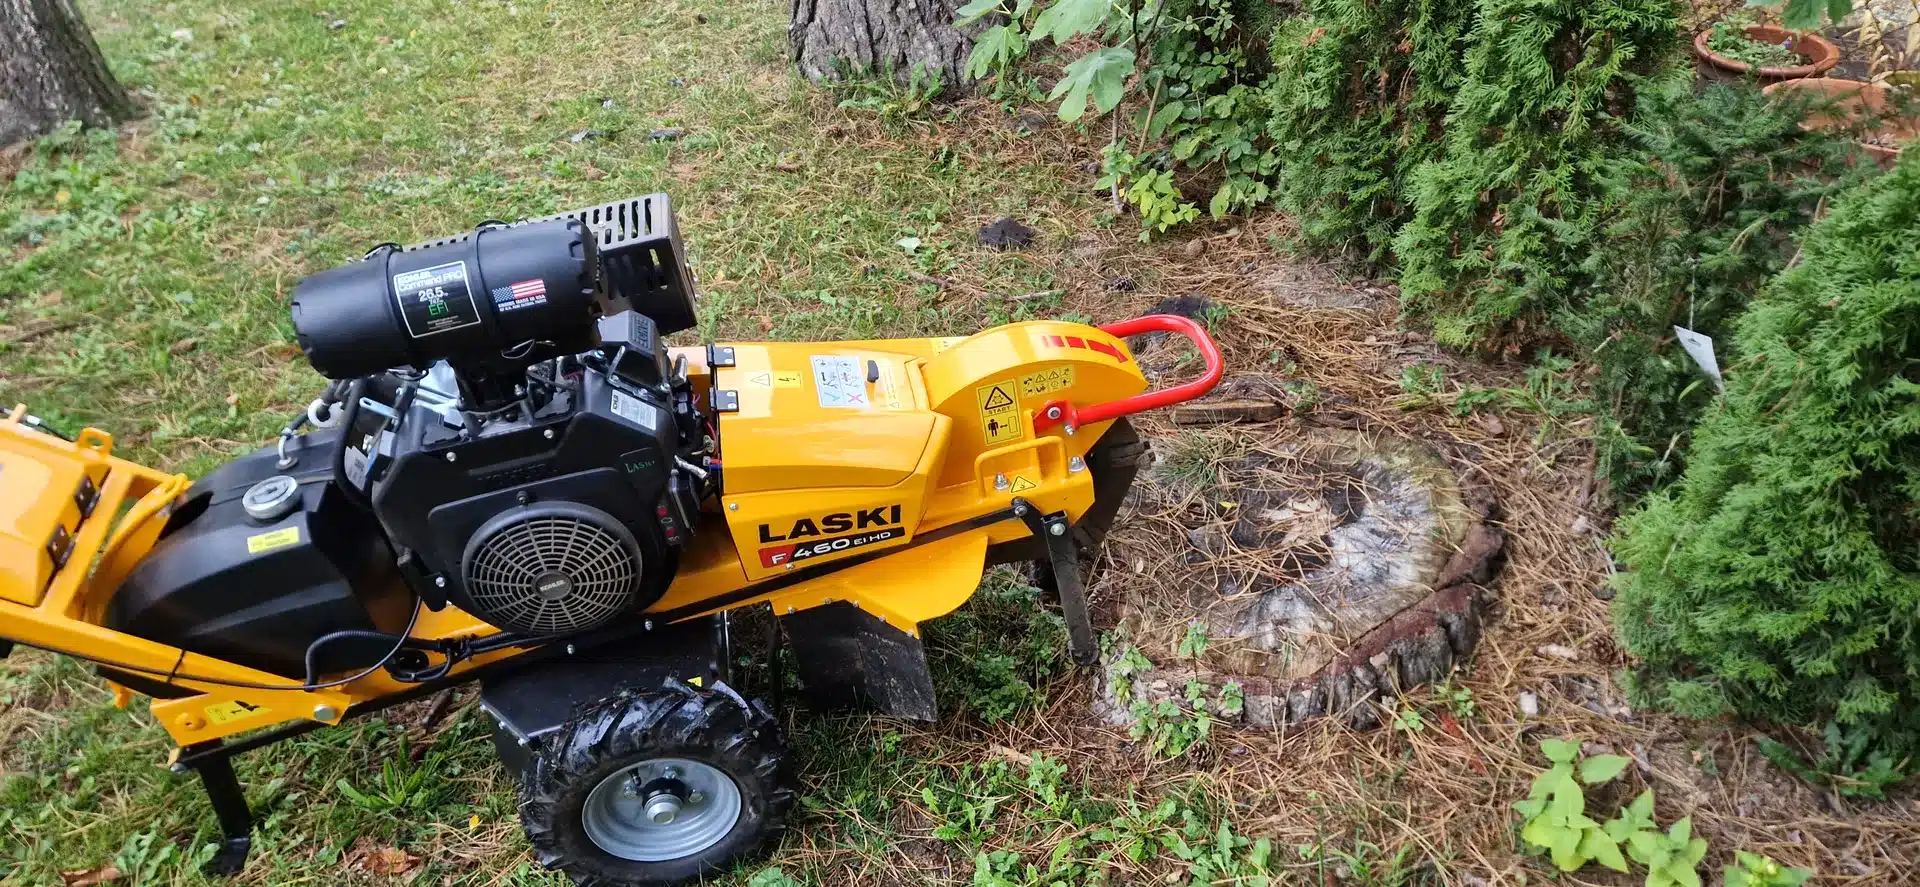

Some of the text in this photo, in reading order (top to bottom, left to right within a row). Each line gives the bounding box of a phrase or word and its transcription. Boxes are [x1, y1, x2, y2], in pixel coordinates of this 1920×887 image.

[399, 270, 463, 291] Command PRO
[418, 286, 444, 302] 26.5
[428, 301, 449, 316] EFI
[988, 406, 1010, 414] START
[758, 504, 902, 544] LASKI
[771, 531, 891, 565] F 460 EI HD
[539, 579, 566, 592] KOHLER
